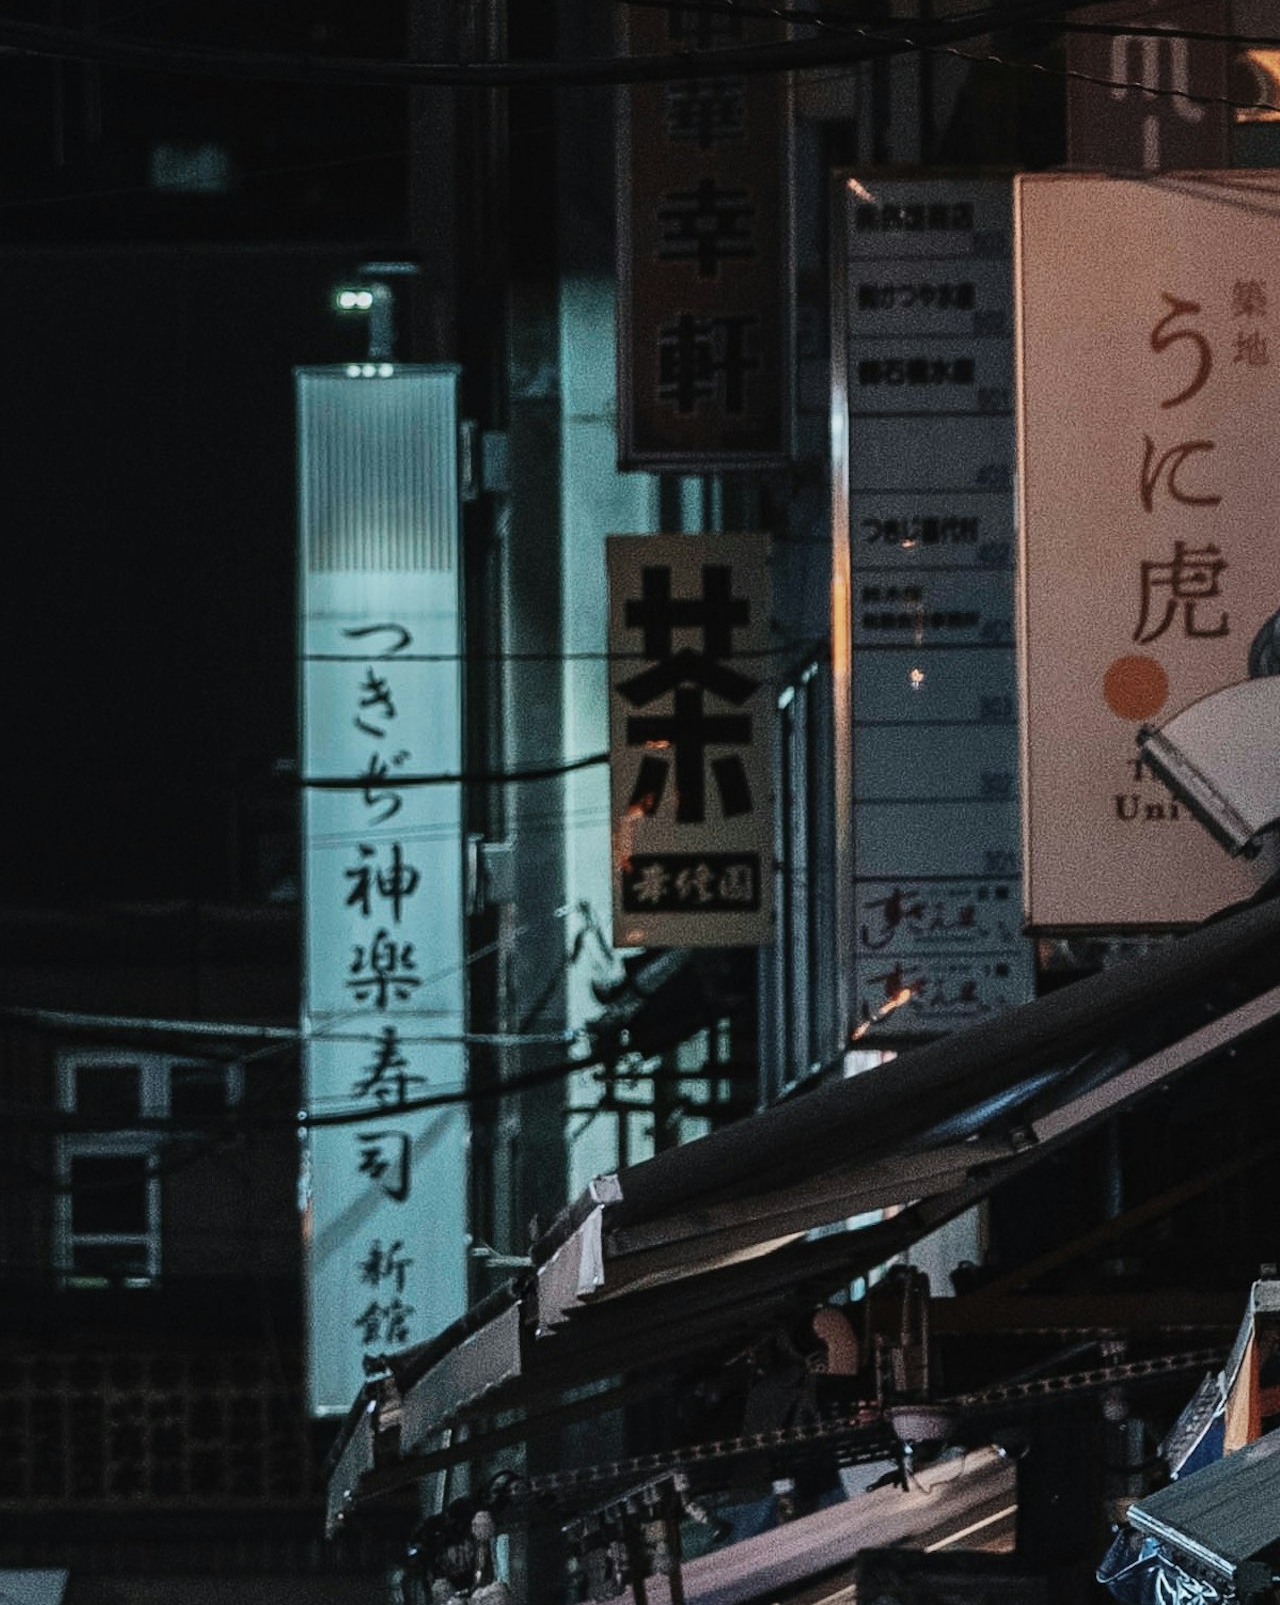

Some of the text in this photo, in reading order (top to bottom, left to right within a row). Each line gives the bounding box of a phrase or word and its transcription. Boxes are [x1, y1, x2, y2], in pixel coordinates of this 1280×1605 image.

[1231, 279, 1269, 368] 築地
[1130, 288, 1231, 648] うに虎
[614, 564, 761, 825] 茶
